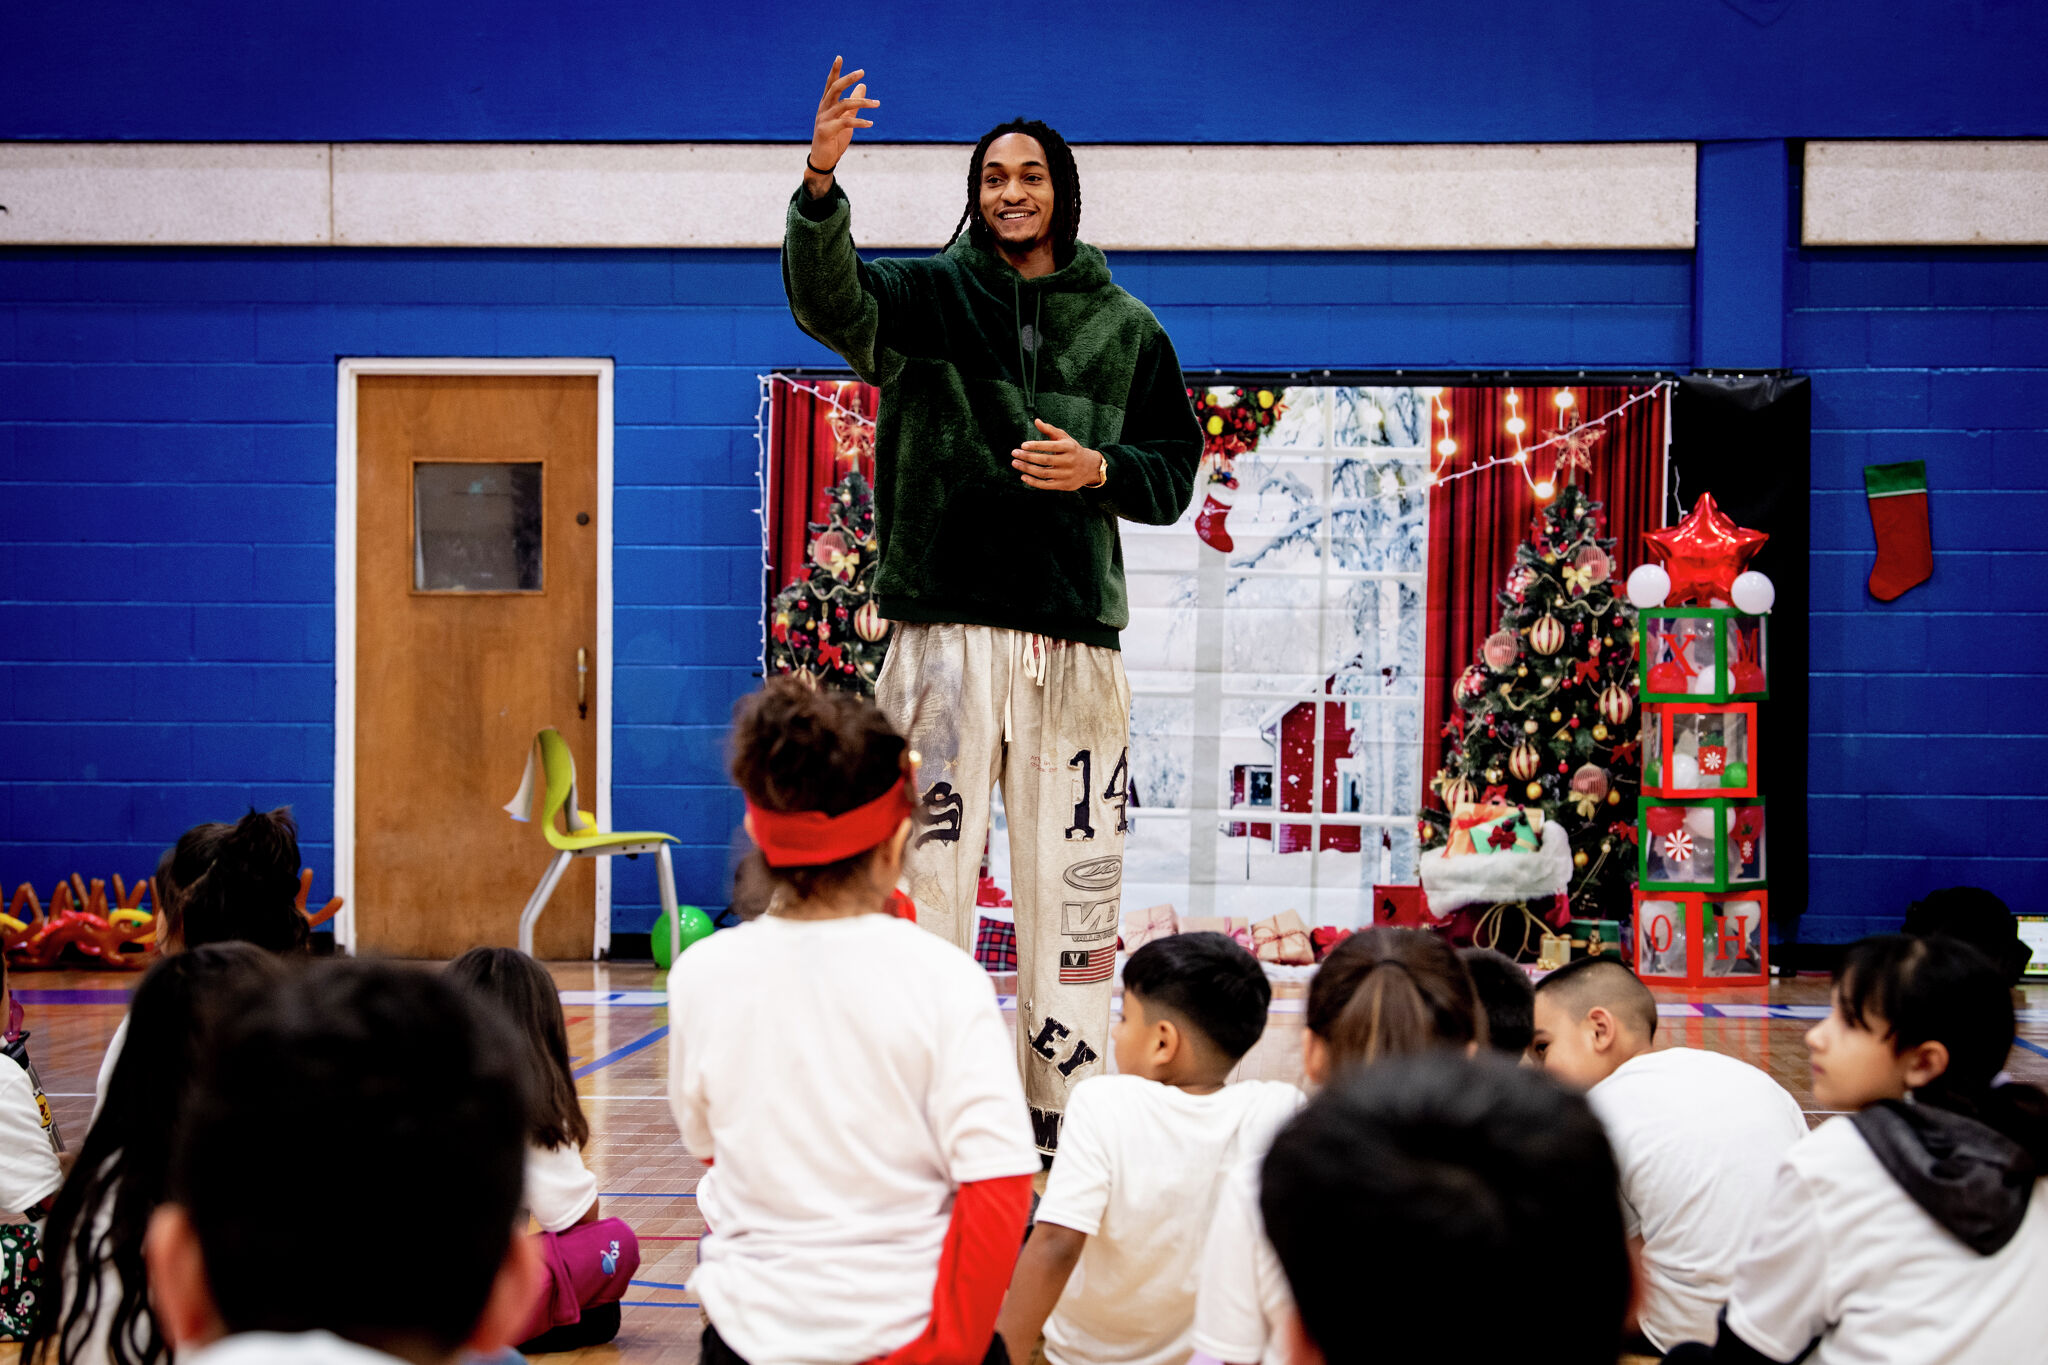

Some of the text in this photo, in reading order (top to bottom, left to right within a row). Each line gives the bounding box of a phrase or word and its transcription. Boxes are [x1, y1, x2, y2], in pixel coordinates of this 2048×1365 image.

[1660, 634, 1698, 677] X
[1065, 746, 1128, 840] 14
[1651, 915, 1672, 952] O
[1714, 916, 1749, 959] H
